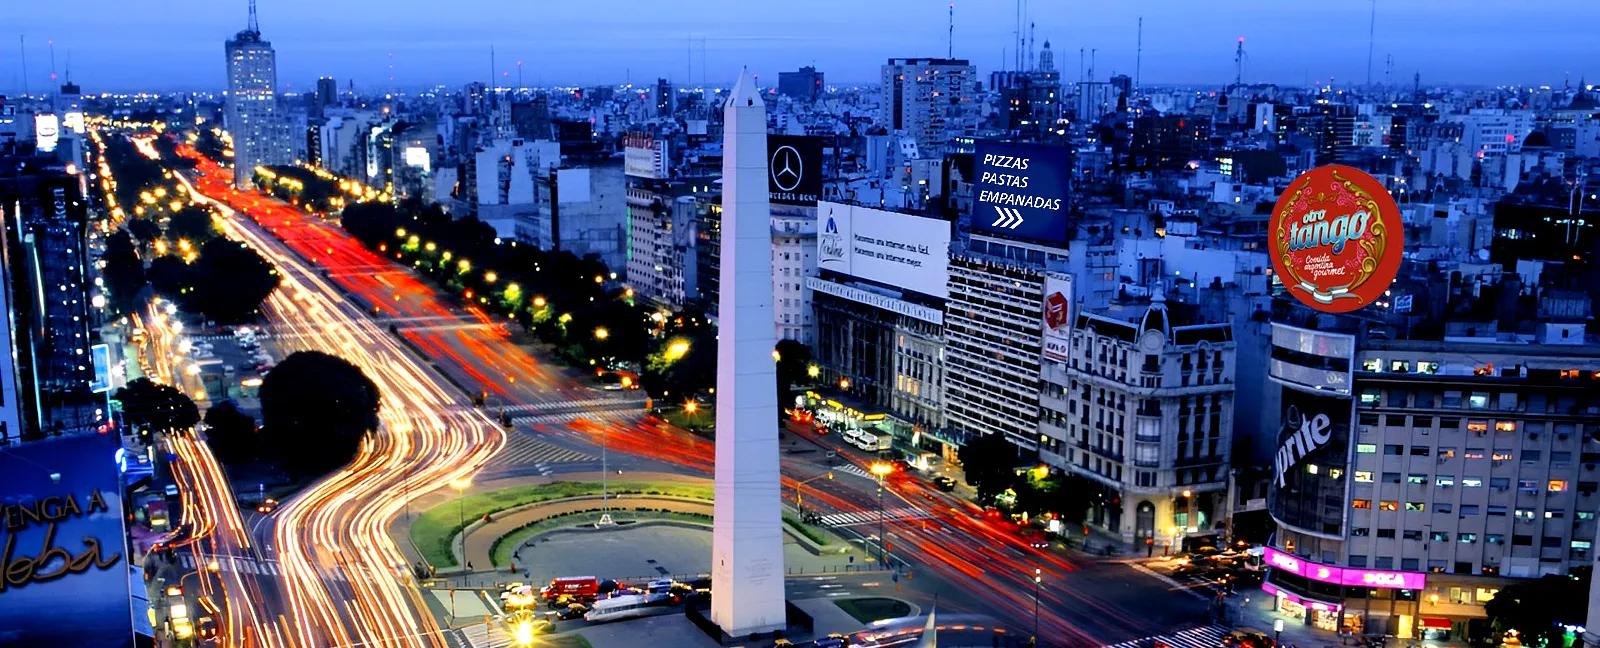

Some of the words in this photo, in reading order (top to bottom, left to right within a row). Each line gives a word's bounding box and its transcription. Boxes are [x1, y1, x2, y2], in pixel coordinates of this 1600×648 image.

[983, 153, 1030, 170] PIZZAS
[981, 171, 1029, 188] PASTAS
[979, 189, 1062, 211] EMPANADAS
[1302, 209, 1326, 224] otro
[1289, 210, 1372, 255] tango
[1313, 266, 1346, 281] gourmet
[1274, 410, 1332, 489] prite
[0, 493, 80, 529] ENGA
[88, 487, 106, 511] A
